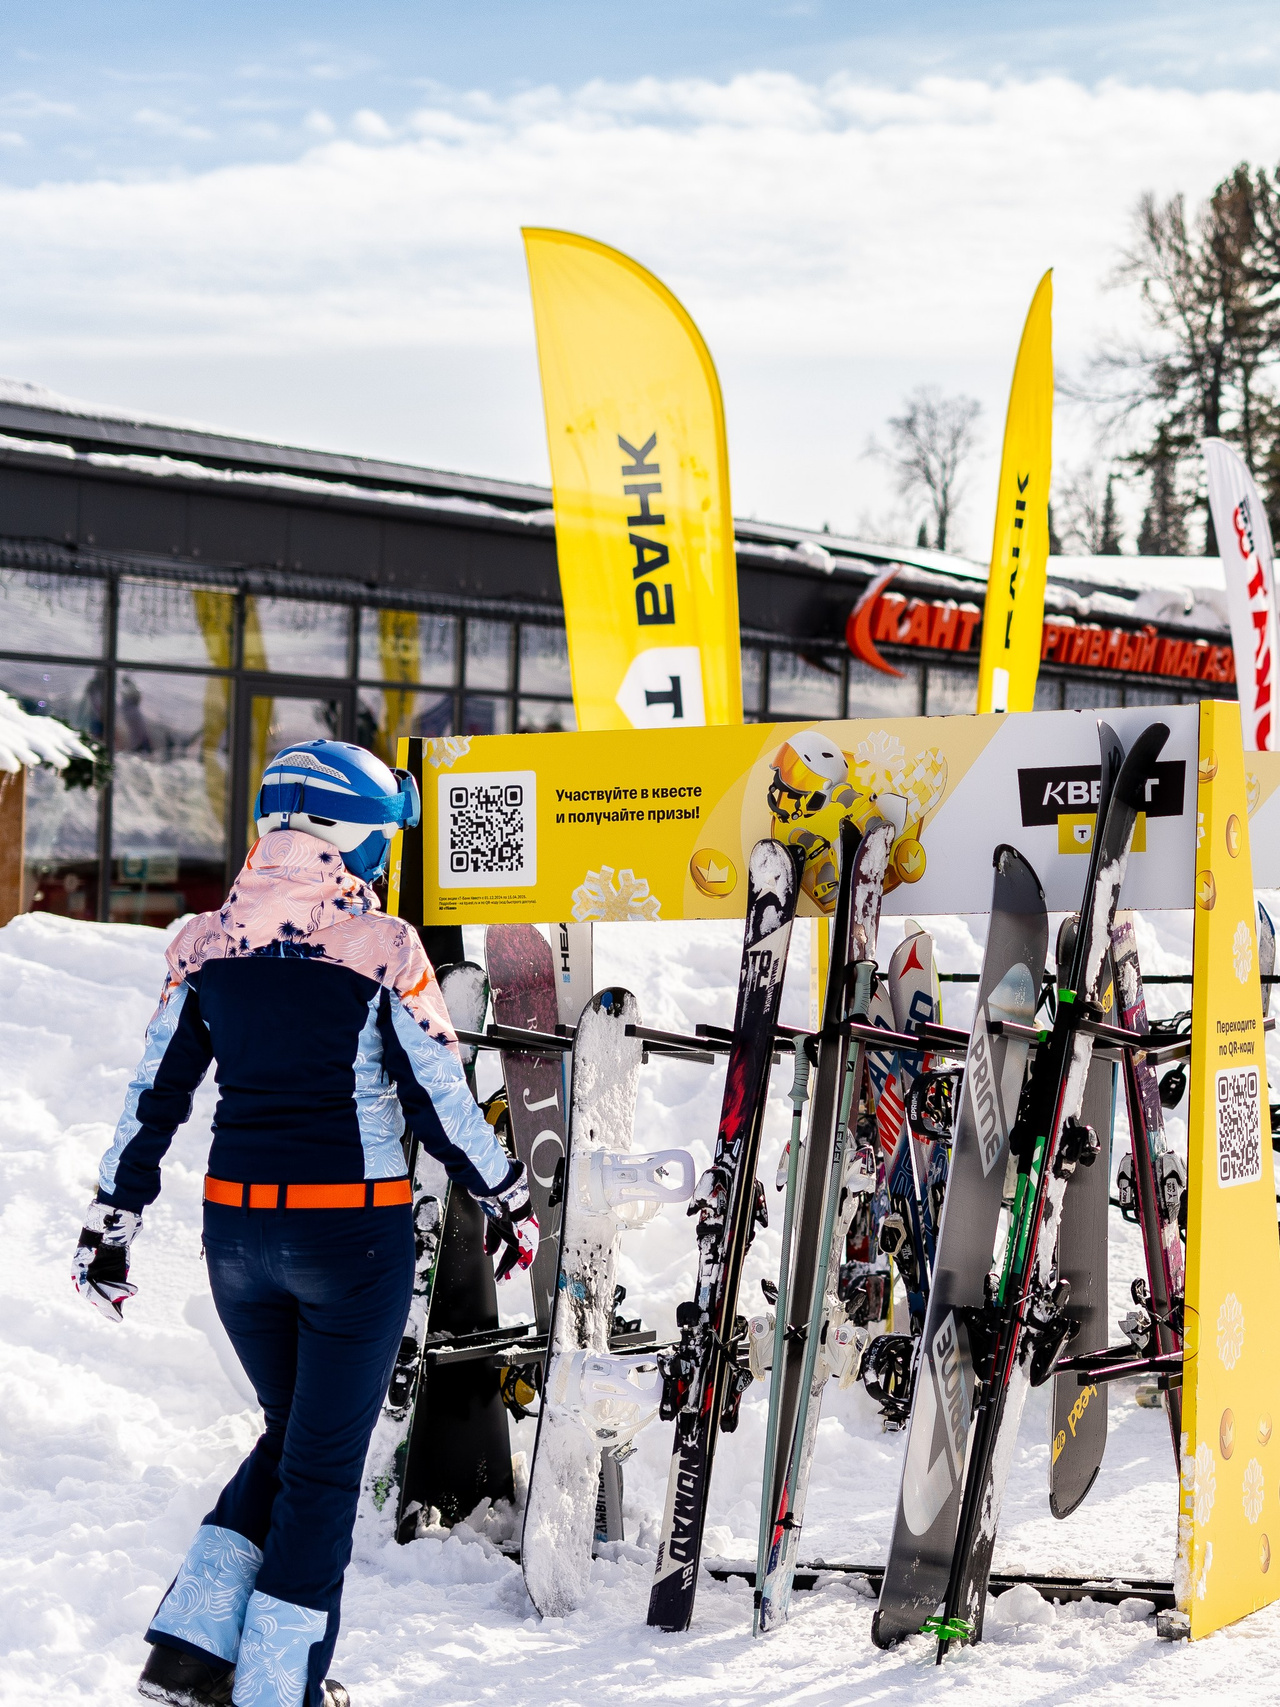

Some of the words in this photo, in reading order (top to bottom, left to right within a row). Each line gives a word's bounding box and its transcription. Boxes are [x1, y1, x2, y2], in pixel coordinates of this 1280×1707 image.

[873, 597, 981, 652] КАНТ
[1041, 623, 1159, 673] РТИВНЫЙ
[1159, 638, 1237, 684] МАГАЗ
[556, 786, 638, 804] Участвуйте
[641, 788, 649, 799] в
[652, 786, 702, 799] квесте
[1042, 777, 1160, 806] КВЕТ
[556, 813, 565, 824] и
[568, 808, 645, 825] получайте
[648, 806, 700, 823] призы!
[1078, 829, 1087, 839] Т
[559, 923, 571, 972] HEA
[1216, 1018, 1256, 1036] Переходите
[1219, 1044, 1228, 1056] по
[1228, 1041, 1255, 1058] QR-коду
[655, 1541, 666, 1575] SMOKE
[681, 1559, 695, 1591] 164
